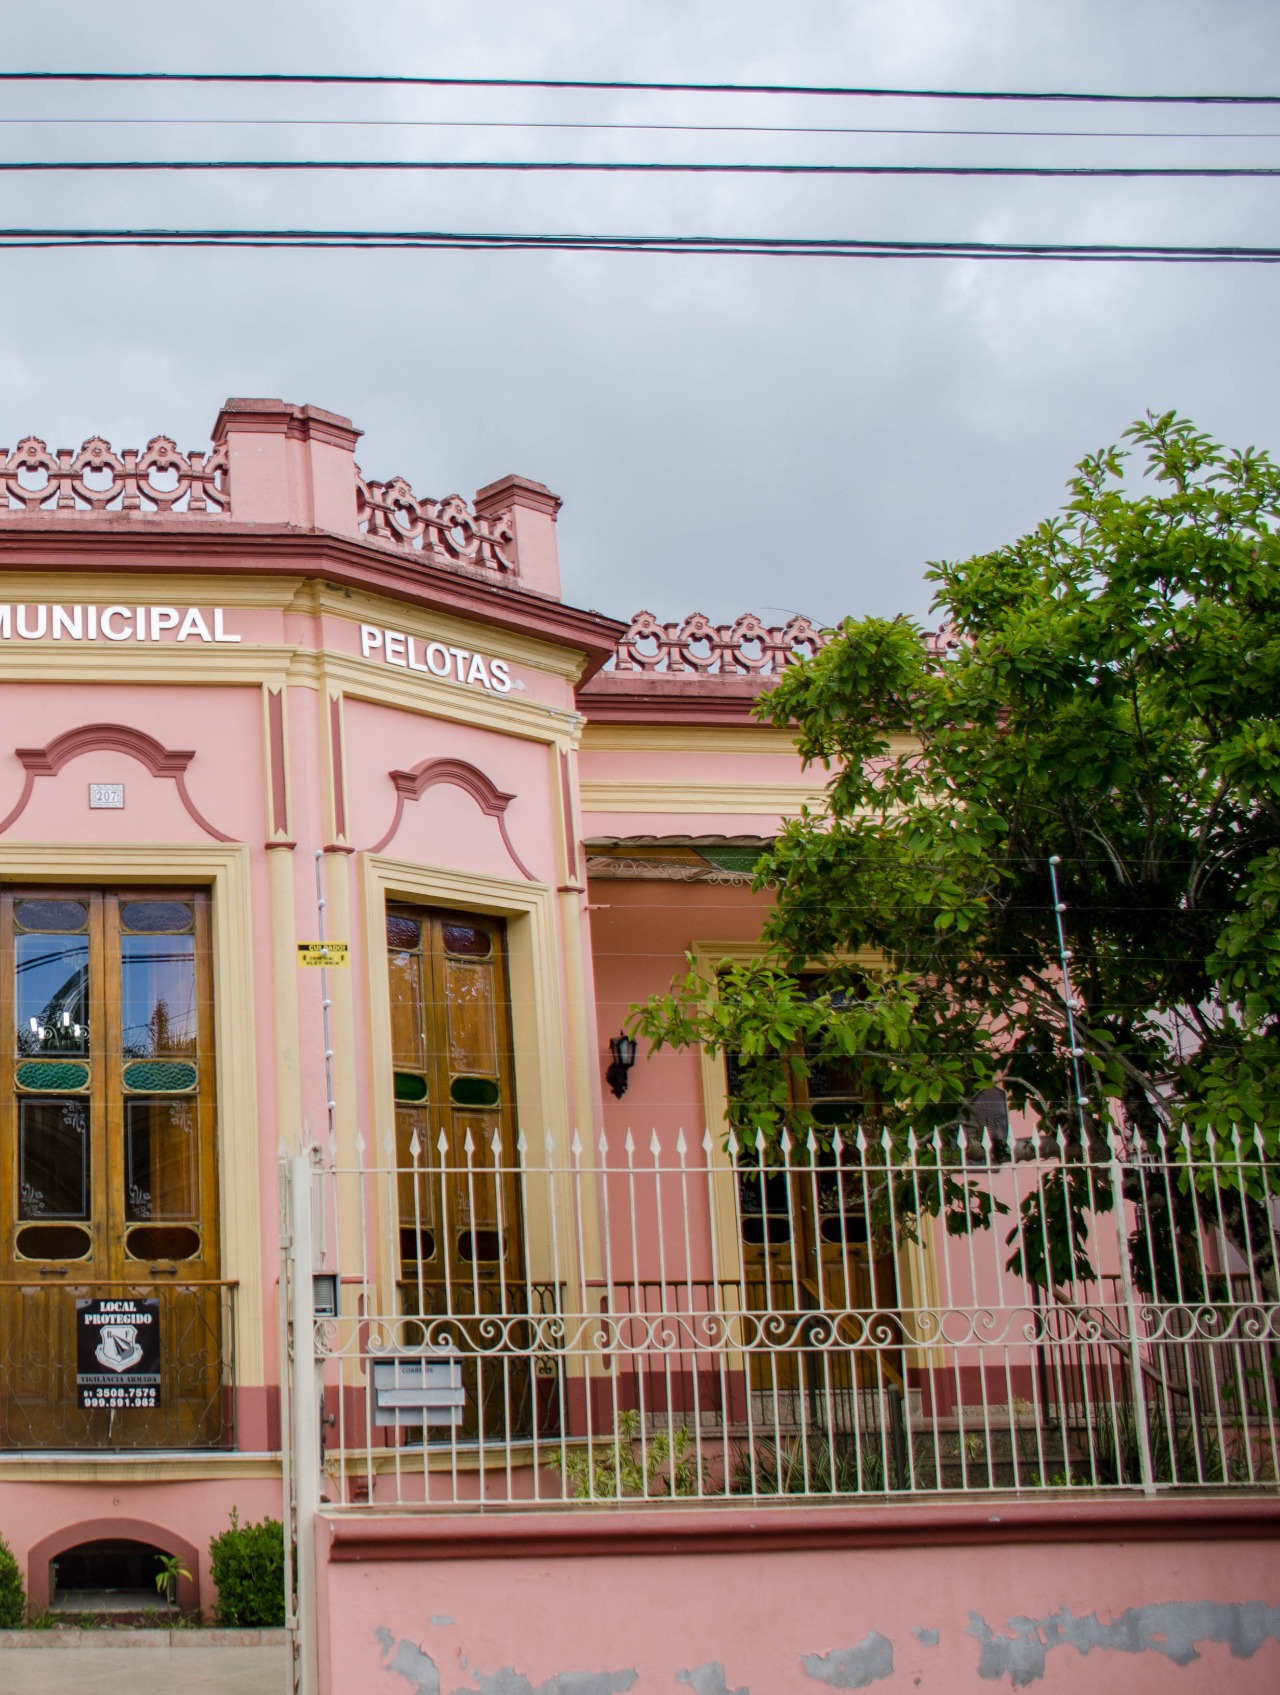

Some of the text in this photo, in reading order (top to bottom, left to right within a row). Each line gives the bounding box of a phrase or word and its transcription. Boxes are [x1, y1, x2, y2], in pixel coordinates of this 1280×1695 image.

[360, 624, 512, 693] PELOTAS
[96, 790, 117, 802] 207
[100, 1301, 137, 1312] LOCAL
[84, 1313, 153, 1325] PROTEGIDO
[81, 1375, 124, 1383] VIGILÂNCIA
[96, 1388, 156, 1397] 3508.7576
